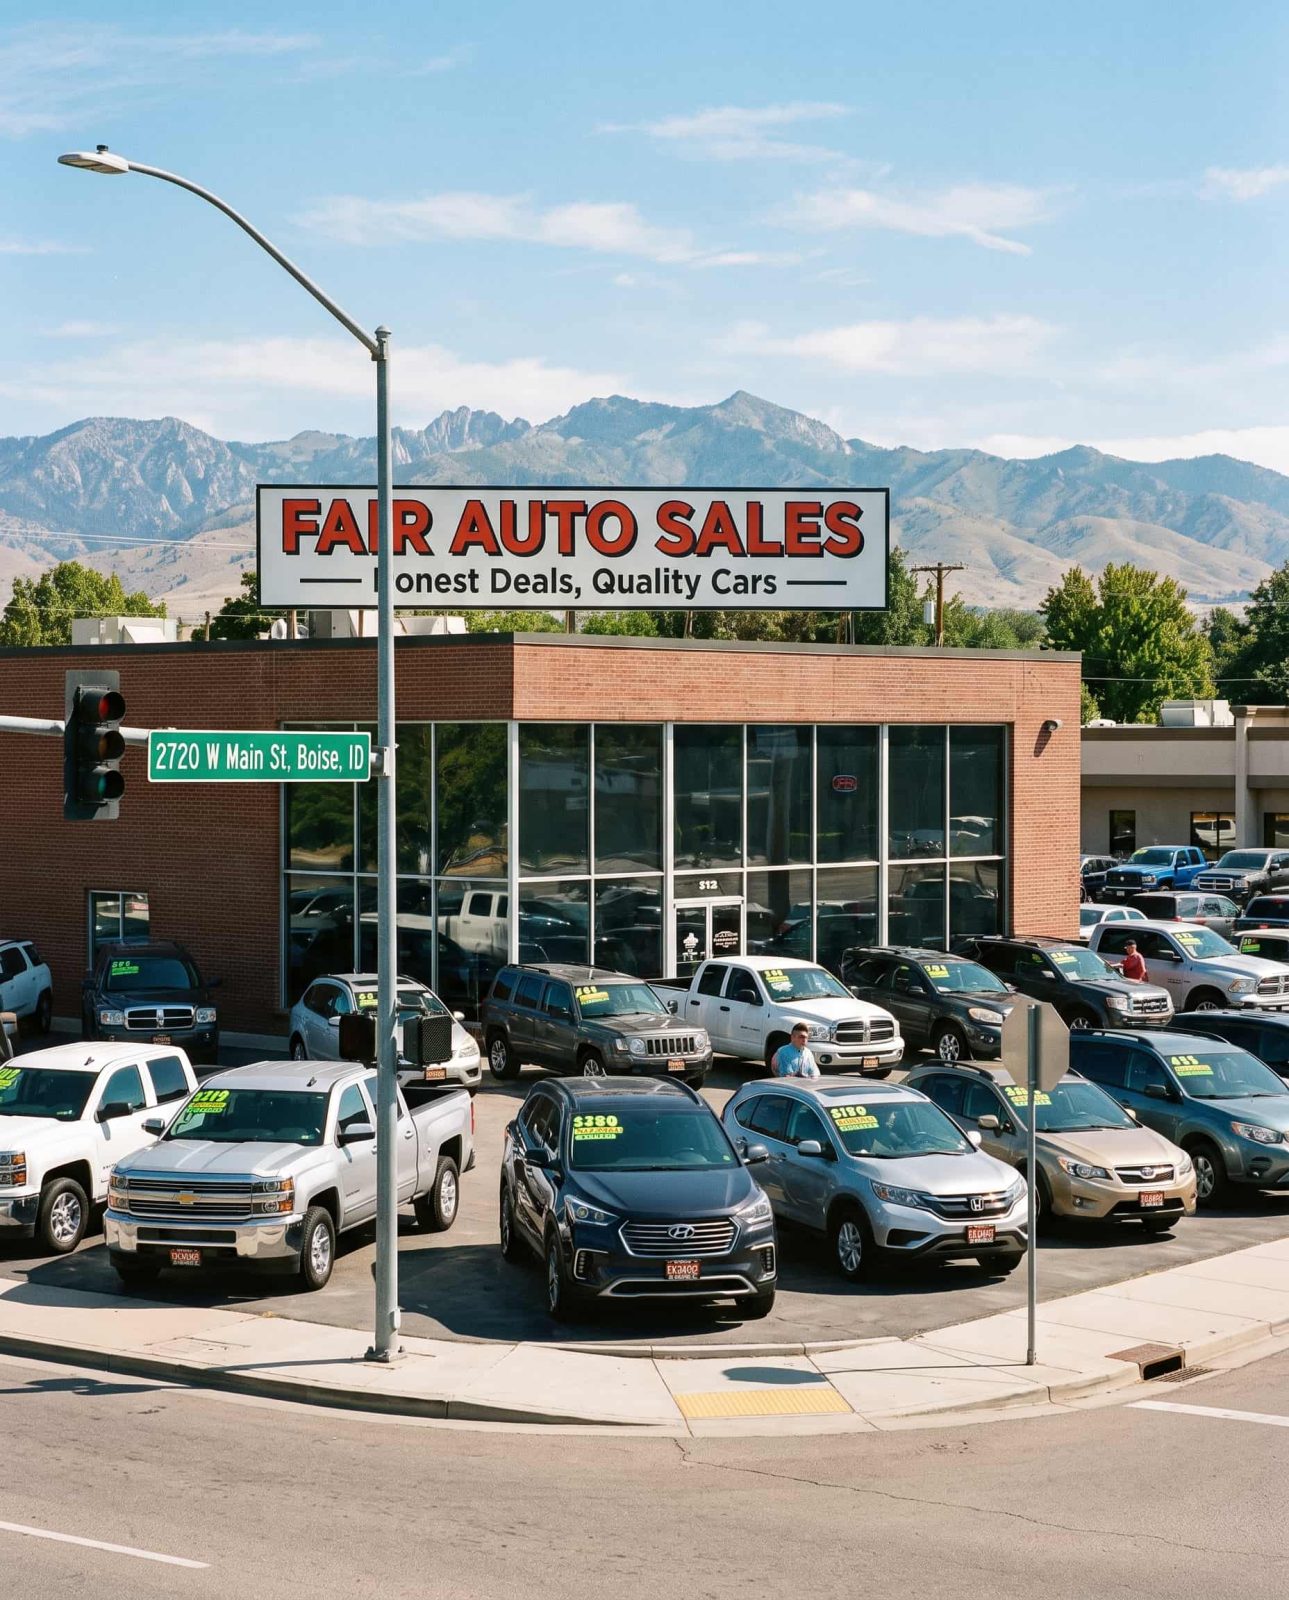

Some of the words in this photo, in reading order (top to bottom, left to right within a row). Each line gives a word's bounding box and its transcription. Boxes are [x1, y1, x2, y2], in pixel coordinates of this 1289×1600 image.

[282, 498, 435, 556] FAIR
[449, 499, 638, 557] AUTO
[655, 500, 865, 558] SALES
[374, 567, 480, 594] onest
[491, 567, 582, 600] Deals,
[593, 567, 702, 601] Quality
[712, 568, 777, 595] Cars
[155, 742, 200, 770] 2720
[206, 743, 220, 770] W
[226, 743, 264, 770] Main
[269, 743, 291, 773] St,
[297, 743, 343, 772] Boise,
[349, 744, 364, 770] ID
